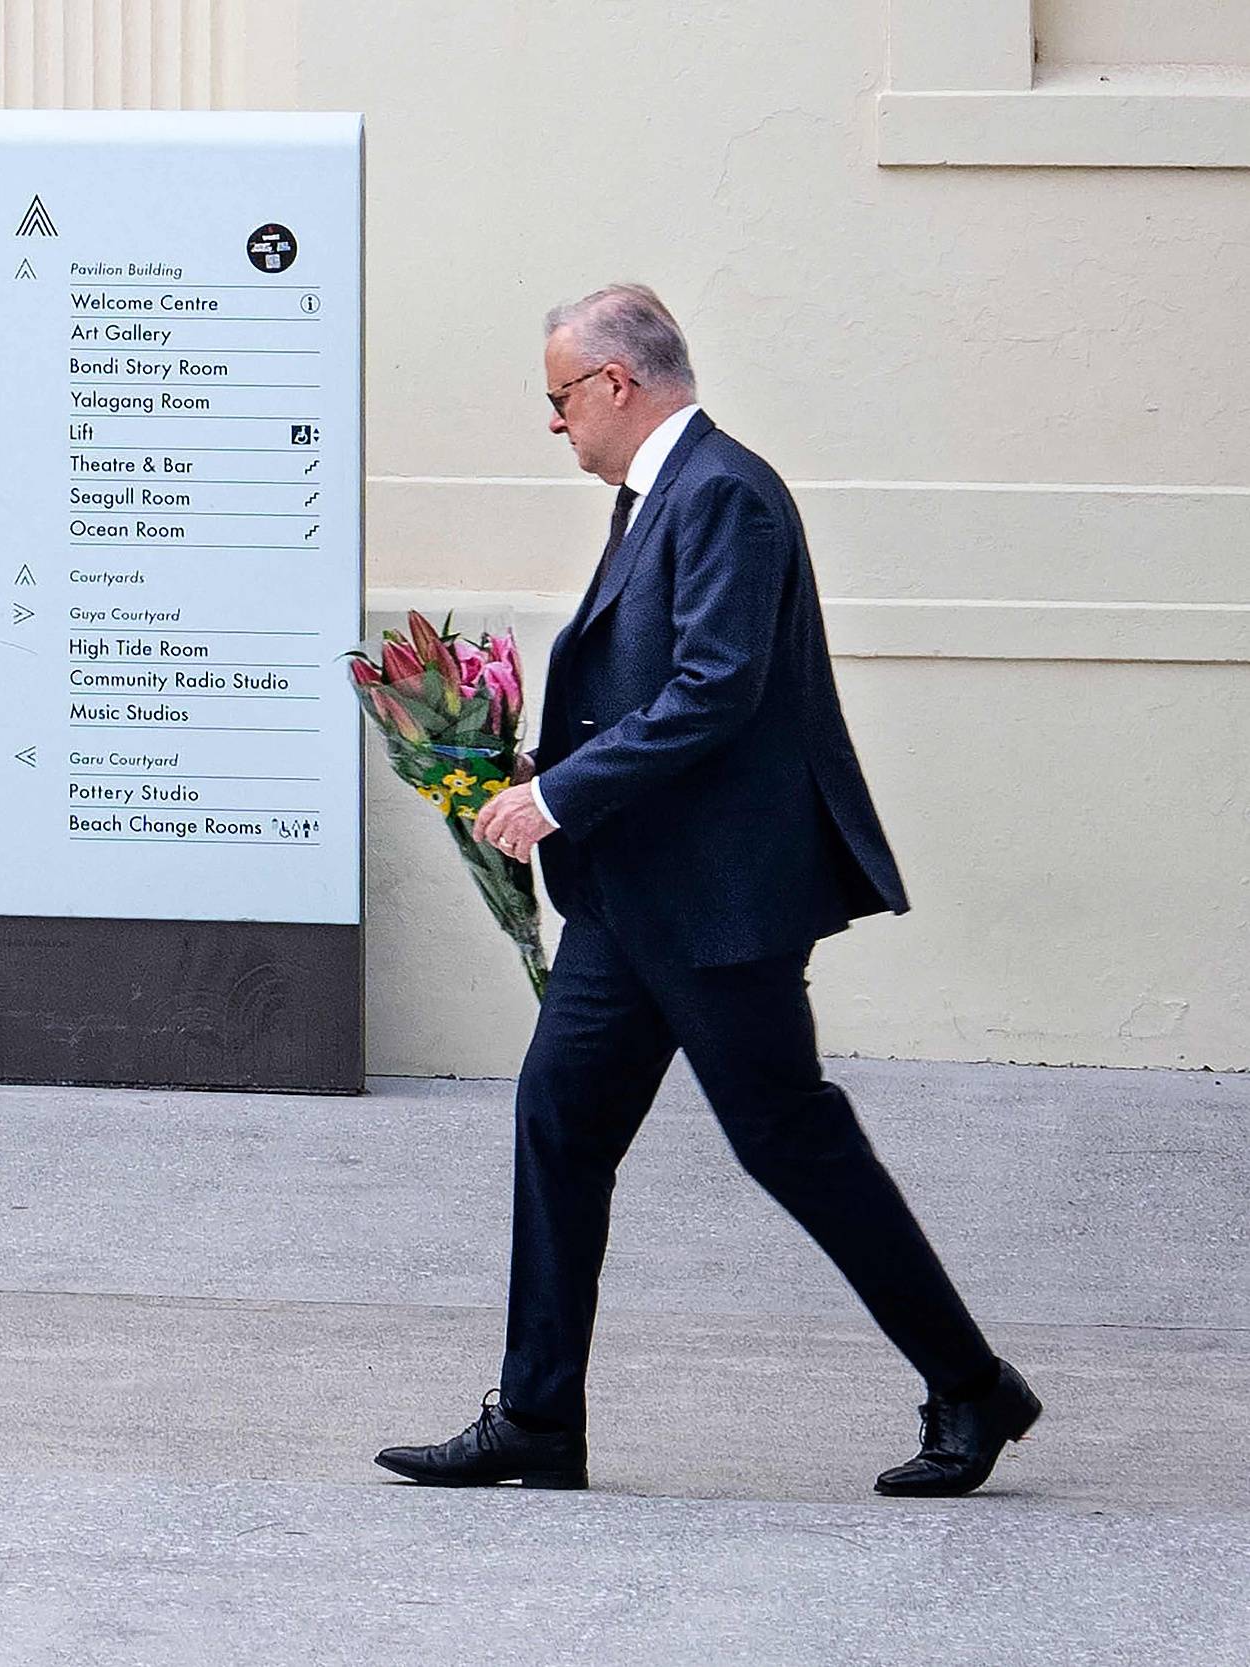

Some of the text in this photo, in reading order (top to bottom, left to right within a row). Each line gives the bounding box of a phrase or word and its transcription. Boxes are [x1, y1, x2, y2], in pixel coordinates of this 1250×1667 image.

[70, 261, 183, 280] Pavilion Building
[70, 292, 219, 311] Welcome Centre
[70, 323, 172, 347] Art Gallery
[69, 357, 228, 381] Bondi Story Room
[70, 389, 210, 413] Yalagang Room
[69, 422, 94, 441] Lift
[69, 454, 194, 474] Theatre & Bar
[69, 487, 190, 510] Seagull Room
[69, 519, 185, 538] Ocean Room
[69, 569, 145, 587] Courtyards
[69, 607, 181, 625] Guya Courtyard
[69, 637, 209, 660] High Tide Room
[69, 669, 289, 693] Community Radio Studio
[69, 702, 189, 722] Music Studios
[69, 751, 179, 770] Garu Courtyard
[69, 783, 199, 805] Pottery Studio
[69, 813, 262, 838] Beach Change Rooms
